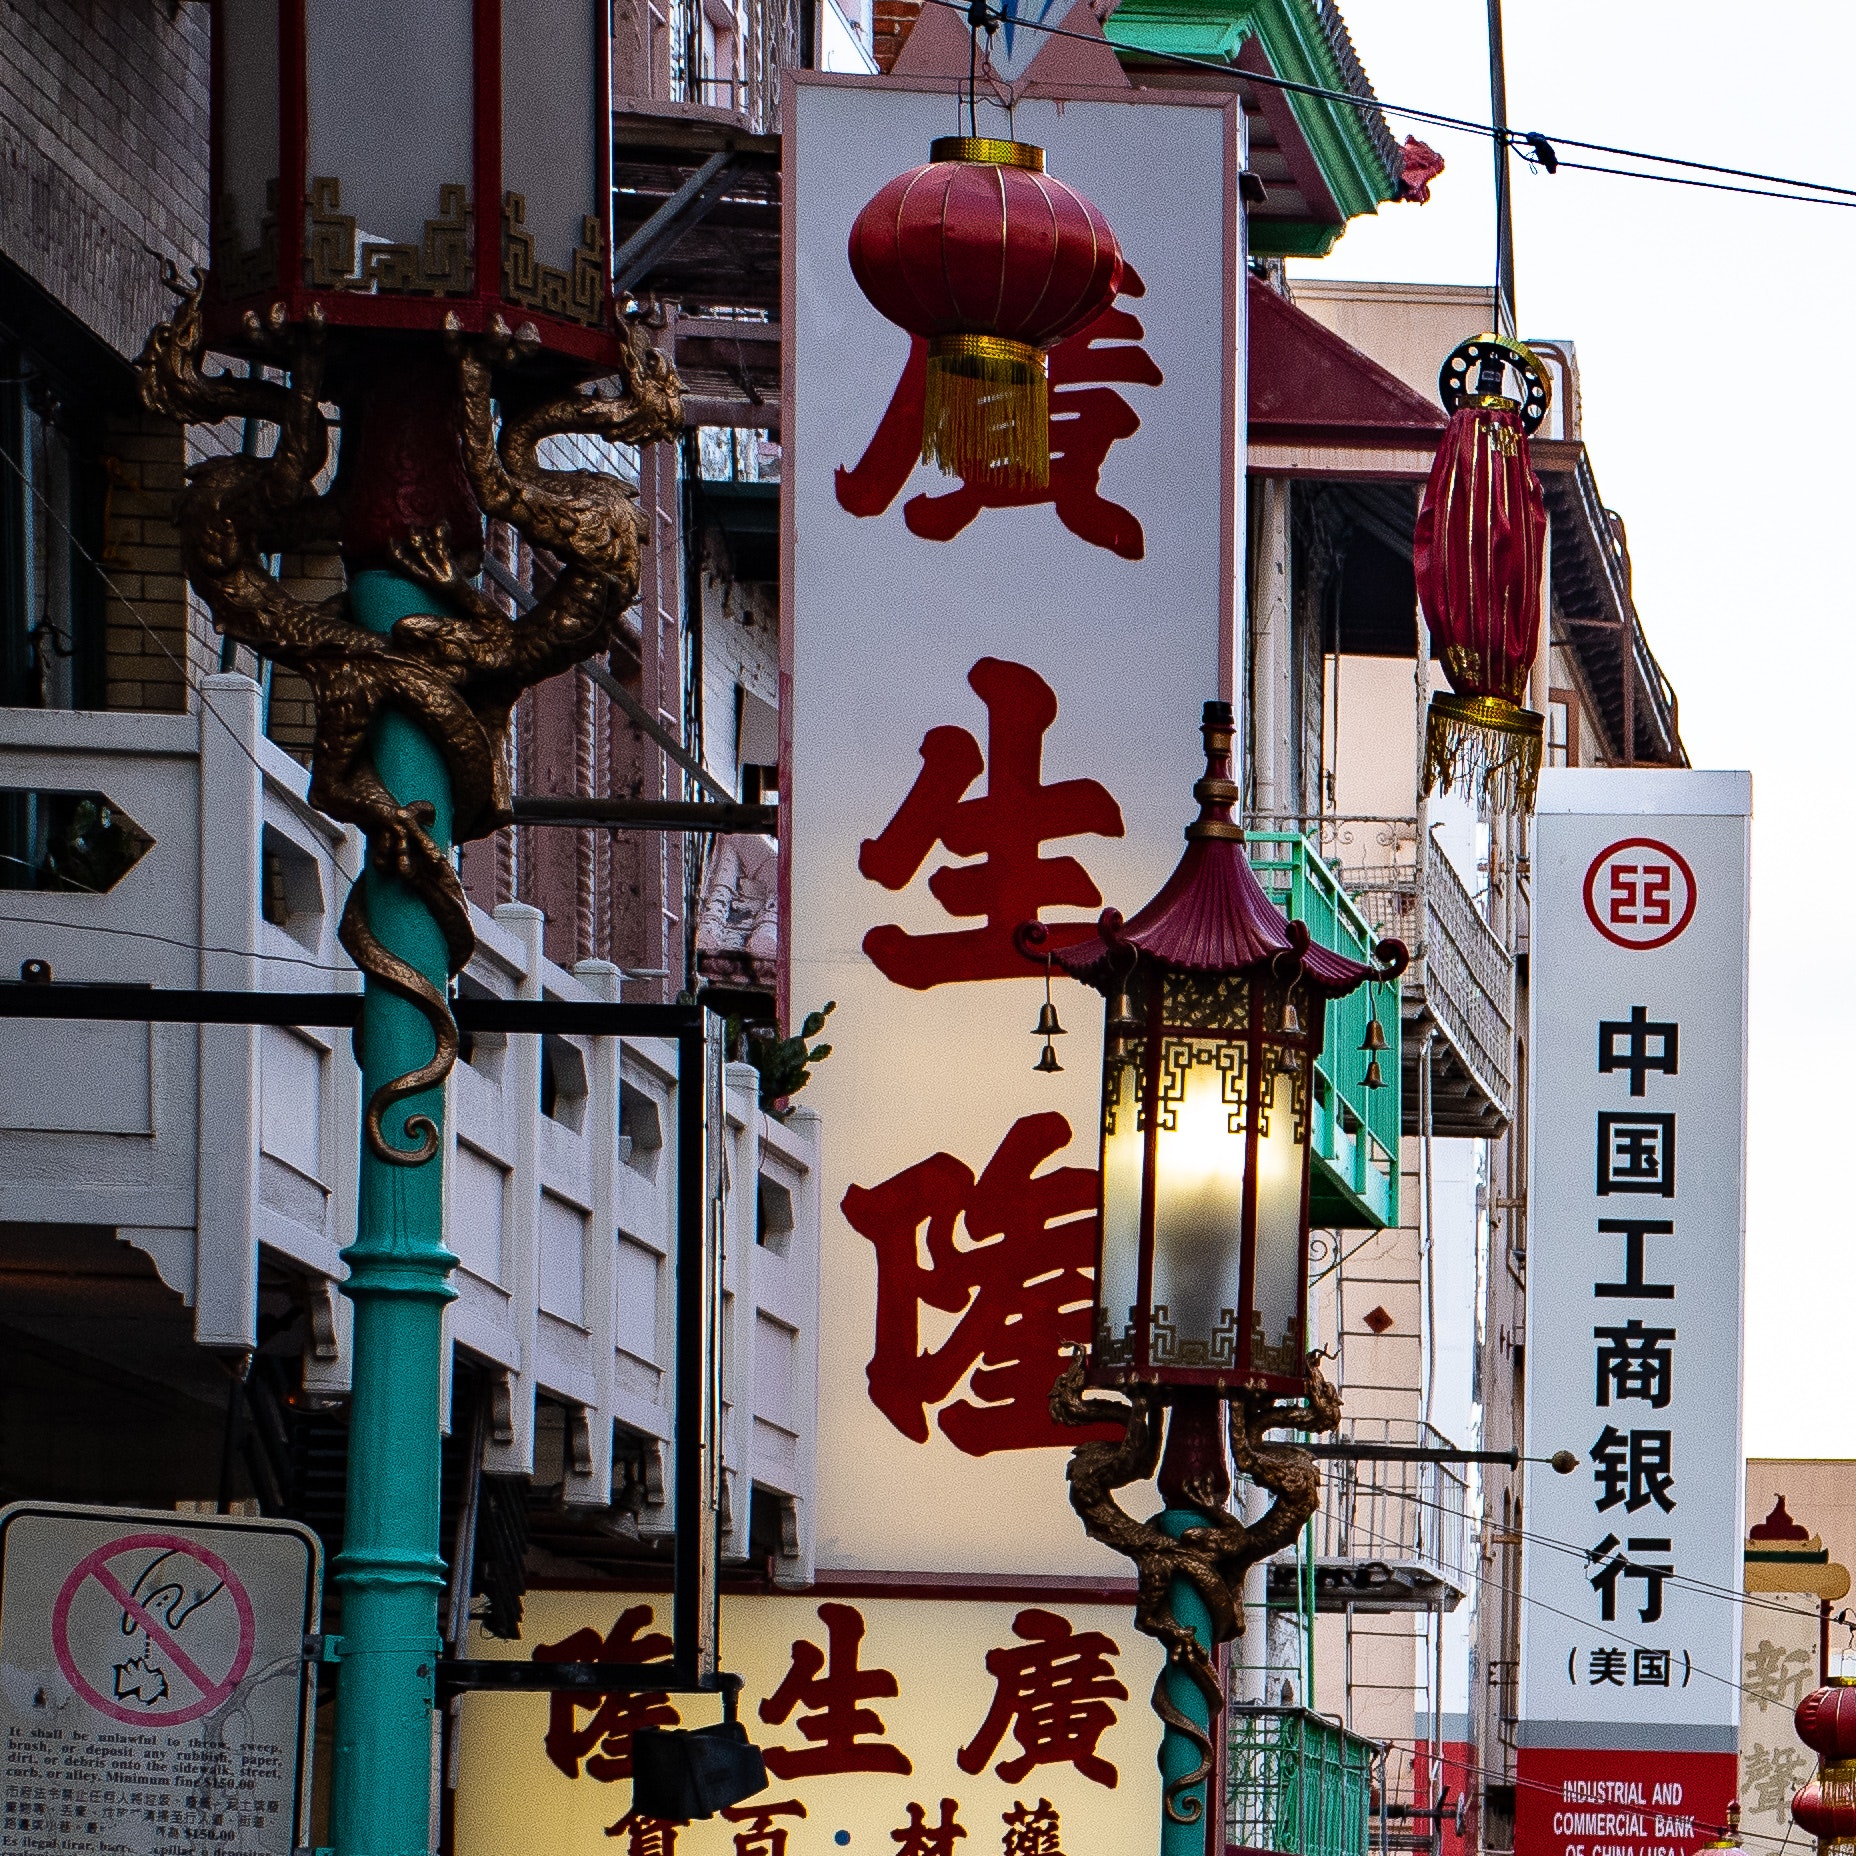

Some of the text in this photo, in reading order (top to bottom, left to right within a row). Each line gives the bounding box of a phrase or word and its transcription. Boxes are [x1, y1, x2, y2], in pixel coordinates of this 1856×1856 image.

[1590, 1007, 1680, 1627] 中国工商银行
[30, 1728, 180, 1747] shall be unlawful to
[86, 1744, 134, 1758] deposit
[143, 1749, 166, 1761] any
[64, 1756, 105, 1768] debris
[112, 1760, 141, 1771] onto
[146, 1761, 167, 1773] the
[106, 1772, 170, 1786] Minimum
[1564, 1782, 1682, 1805] INDUSTRIAL AND
[1554, 1813, 1694, 1837] COMMERCIAL BANK
